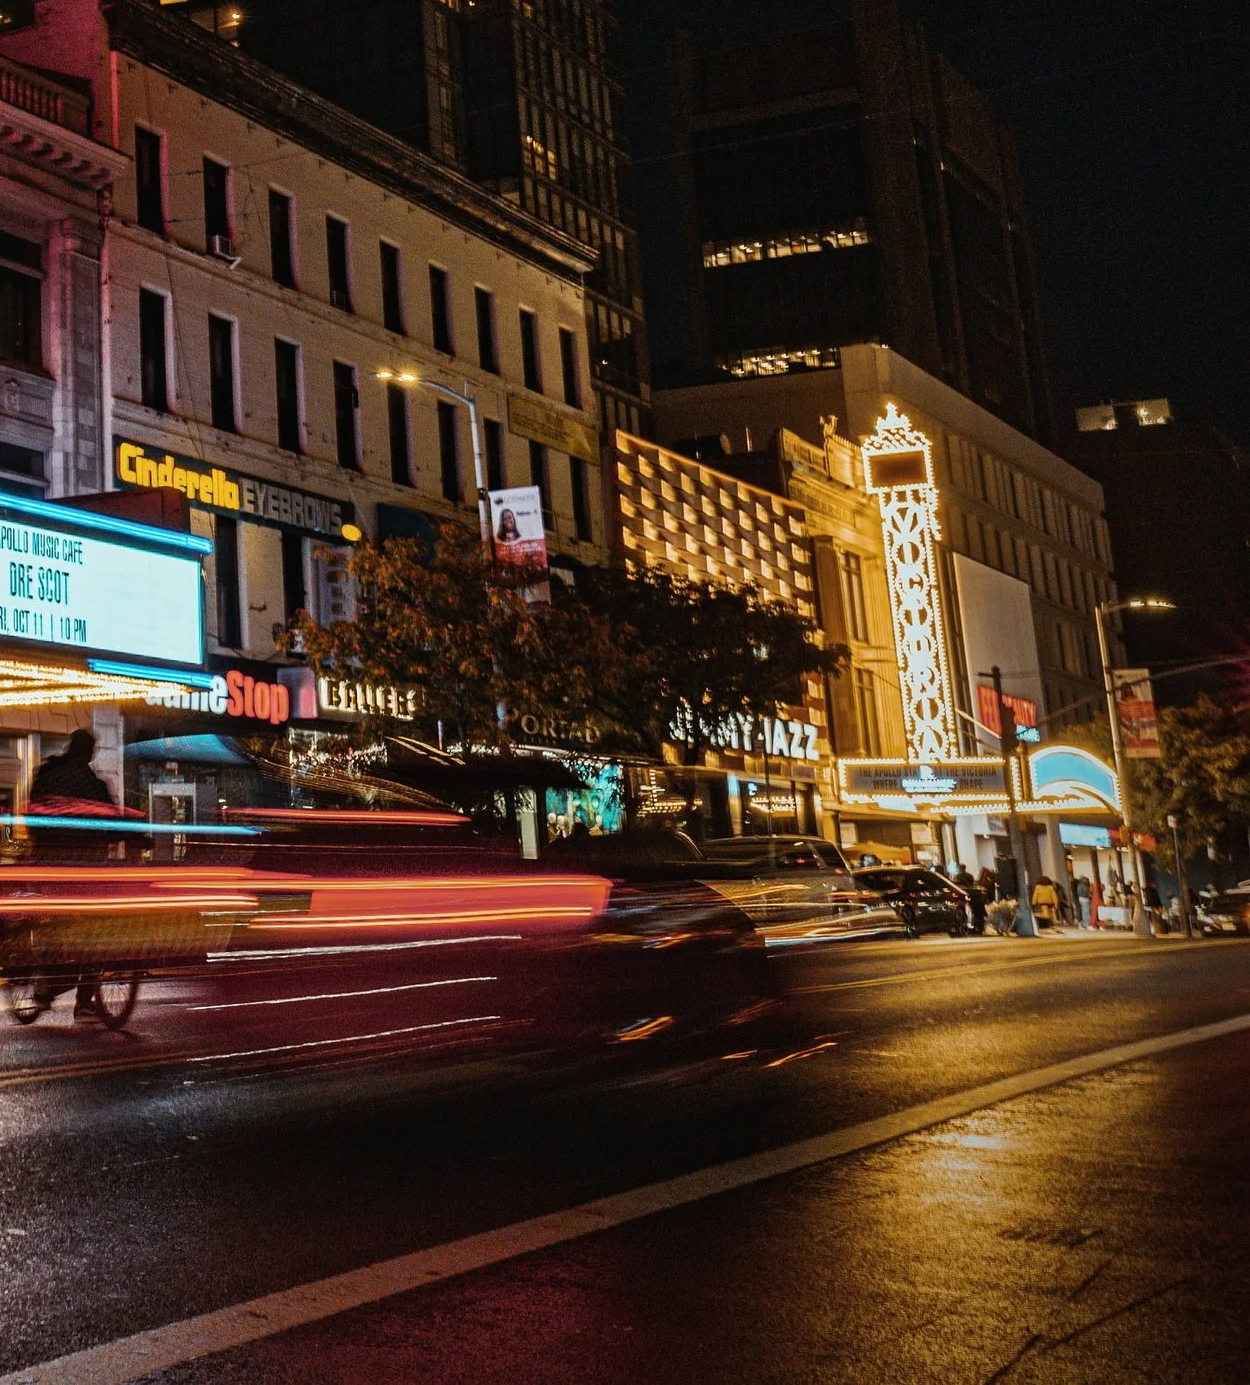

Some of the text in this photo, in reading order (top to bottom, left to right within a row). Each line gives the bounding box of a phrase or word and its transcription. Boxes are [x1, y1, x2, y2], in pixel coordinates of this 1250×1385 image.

[118, 442, 240, 511] Cinderella
[32, 532, 60, 560] MUSIC
[62, 539, 83, 565] CAFE
[9, 561, 70, 606] DRE SCOT
[13, 608, 30, 633] OCT
[33, 612, 44, 636] 11
[60, 616, 71, 640] 10
[73, 618, 87, 643] PM
